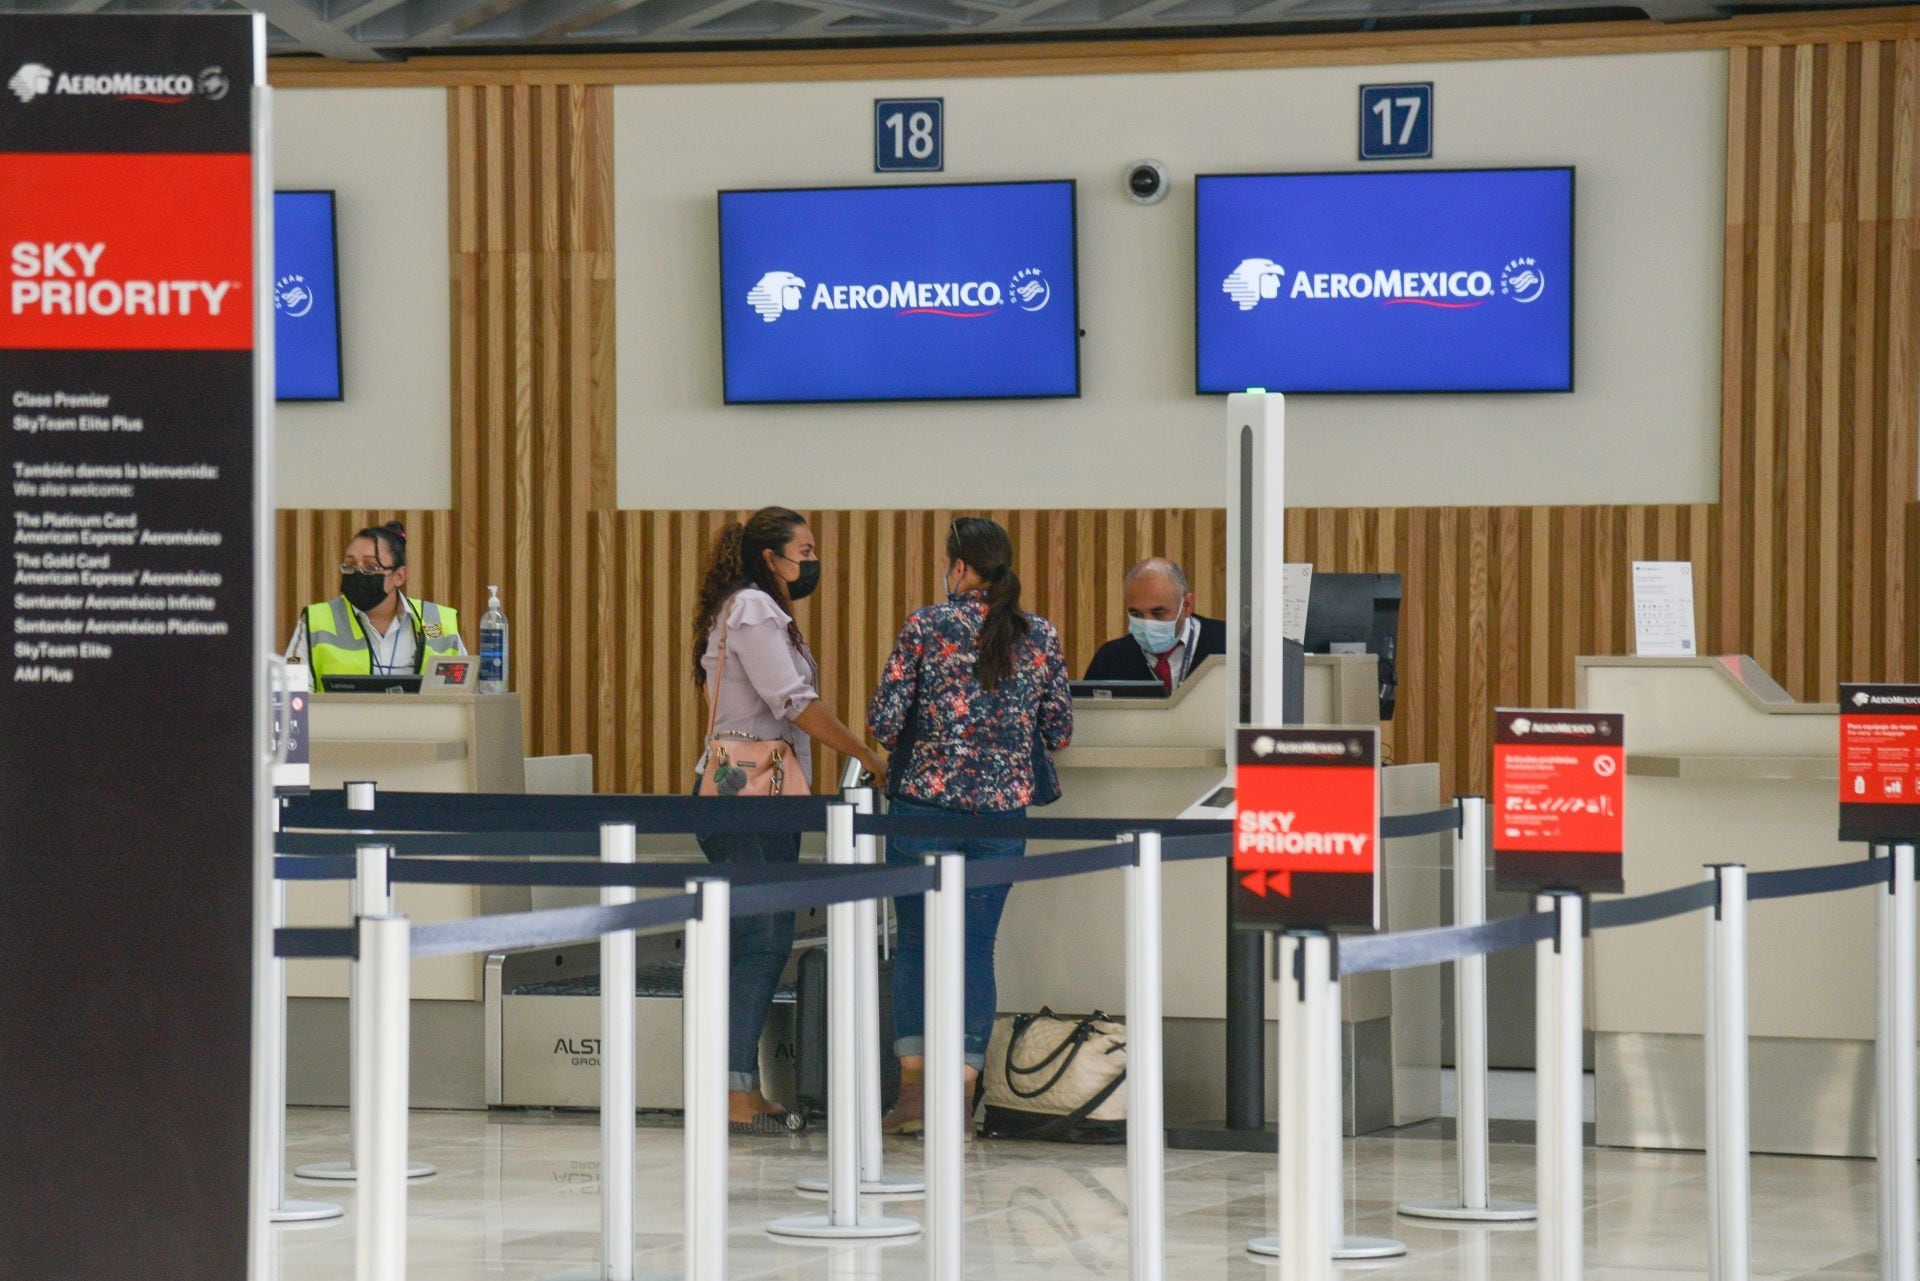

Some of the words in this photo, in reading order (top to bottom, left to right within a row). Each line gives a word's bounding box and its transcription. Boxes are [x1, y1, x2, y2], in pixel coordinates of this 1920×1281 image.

[1372, 96, 1422, 147] 17
[885, 111, 934, 159] 18
[11, 241, 106, 278] SKY
[11, 280, 231, 316] PRIORITY
[13, 391, 52, 408] Clase
[54, 392, 110, 408] Premier
[13, 414, 77, 434] SkyTeam
[79, 415, 110, 432] Elite
[112, 415, 144, 432] Plus
[14, 461, 75, 478] También
[76, 463, 123, 479] damos
[125, 463, 138, 479] la
[14, 482, 37, 497] We
[39, 482, 67, 497] also
[14, 512, 41, 528] The
[43, 512, 102, 528] Platinum
[103, 512, 137, 528] Card
[14, 529, 79, 545] American
[14, 553, 41, 569] The
[43, 553, 75, 569] Gold
[76, 553, 110, 569] Card
[14, 570, 79, 586] American
[14, 593, 84, 610] Santander
[168, 595, 216, 611] Infinite
[14, 617, 84, 634] Santander
[168, 618, 229, 635] Platinum
[14, 641, 78, 660] SkyTeam
[79, 642, 112, 659] Elite
[14, 667, 40, 682] AM
[42, 667, 74, 683] Plus
[1239, 810, 1295, 833] SKY
[1238, 832, 1368, 855] PRIORITY
[554, 1038, 601, 1055] ALST
[572, 1058, 601, 1066] GRO
